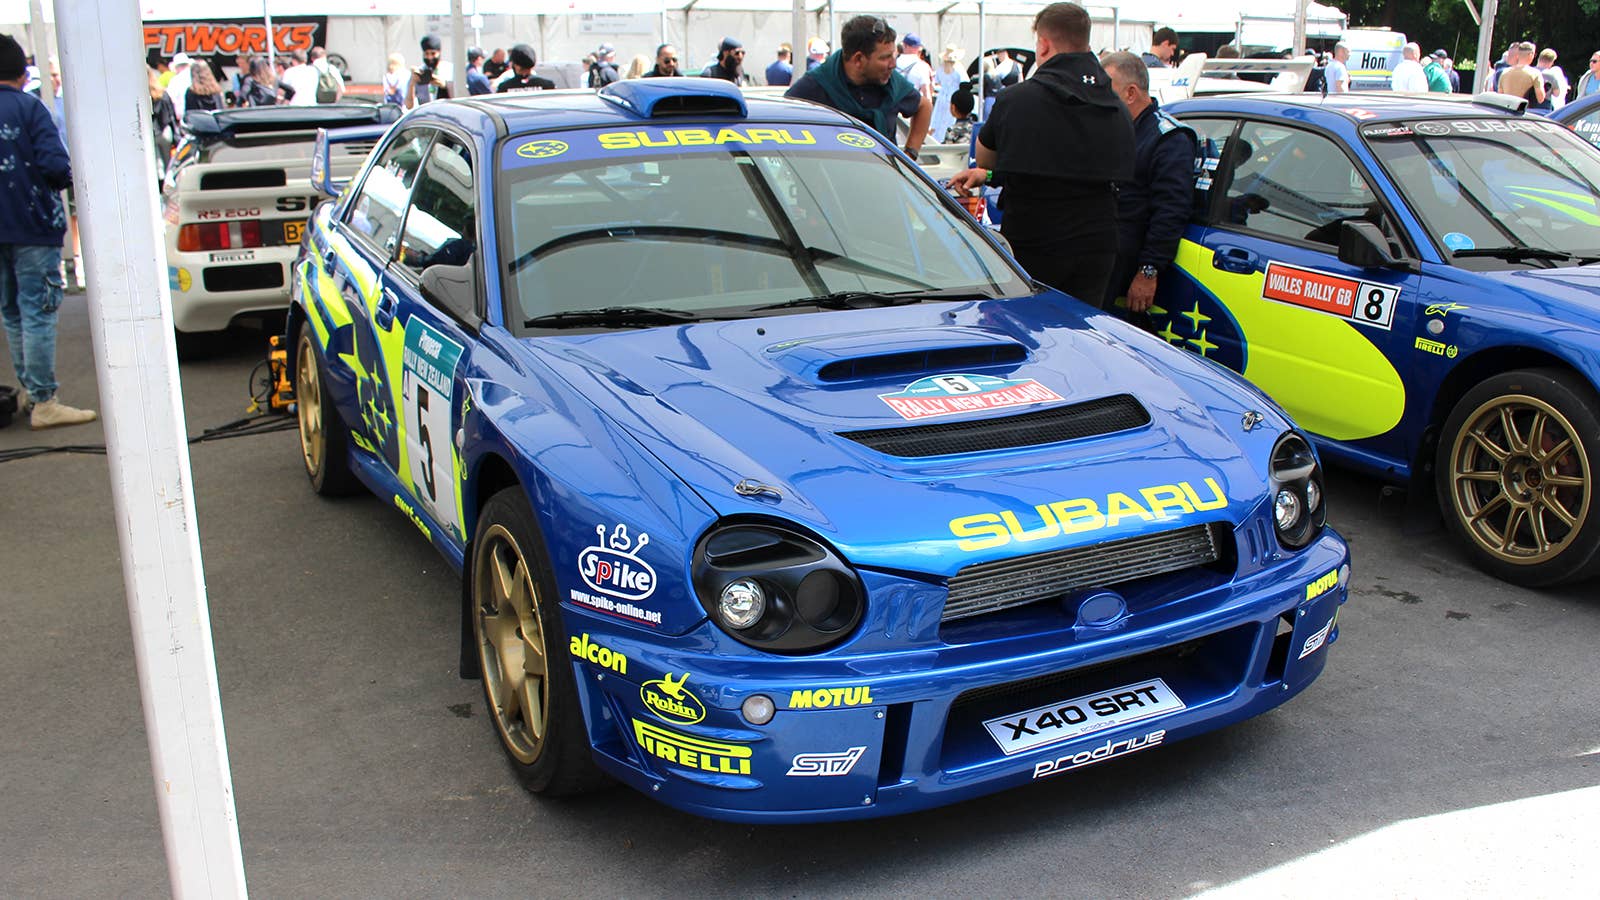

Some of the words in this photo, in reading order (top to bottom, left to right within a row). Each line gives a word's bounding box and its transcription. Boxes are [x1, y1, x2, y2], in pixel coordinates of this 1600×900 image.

[598, 129, 817, 150] SUBARU
[1451, 121, 1562, 134] SUBARU
[1575, 119, 1600, 132] Kan
[198, 209, 221, 219] RS
[225, 207, 261, 218] 200
[209, 250, 254, 262] PIRELLI
[1269, 273, 1302, 295] WALES
[1303, 281, 1335, 303] RALLY
[1336, 288, 1353, 306] GB
[1364, 288, 1385, 321] 8
[1414, 336, 1446, 356] PIRELLI
[416, 355, 429, 381] NEW
[889, 399, 951, 418] RALLY
[946, 393, 982, 412] NEW
[980, 383, 1056, 409] ZEALAND
[942, 377, 968, 392] 5
[417, 384, 436, 503] 5
[949, 477, 1229, 552] SUBARU
[584, 553, 651, 592] Spike
[1306, 569, 1339, 601] MOTUL
[570, 589, 662, 624] www.spike-online.net
[569, 632, 628, 675] alcon
[645, 690, 699, 720] Robin
[789, 686, 873, 709] MOTUL
[1001, 705, 1088, 740] X40
[1088, 686, 1161, 717] SRT
[632, 717, 753, 776] PIRELLI
[1032, 729, 1167, 779] prodrive
